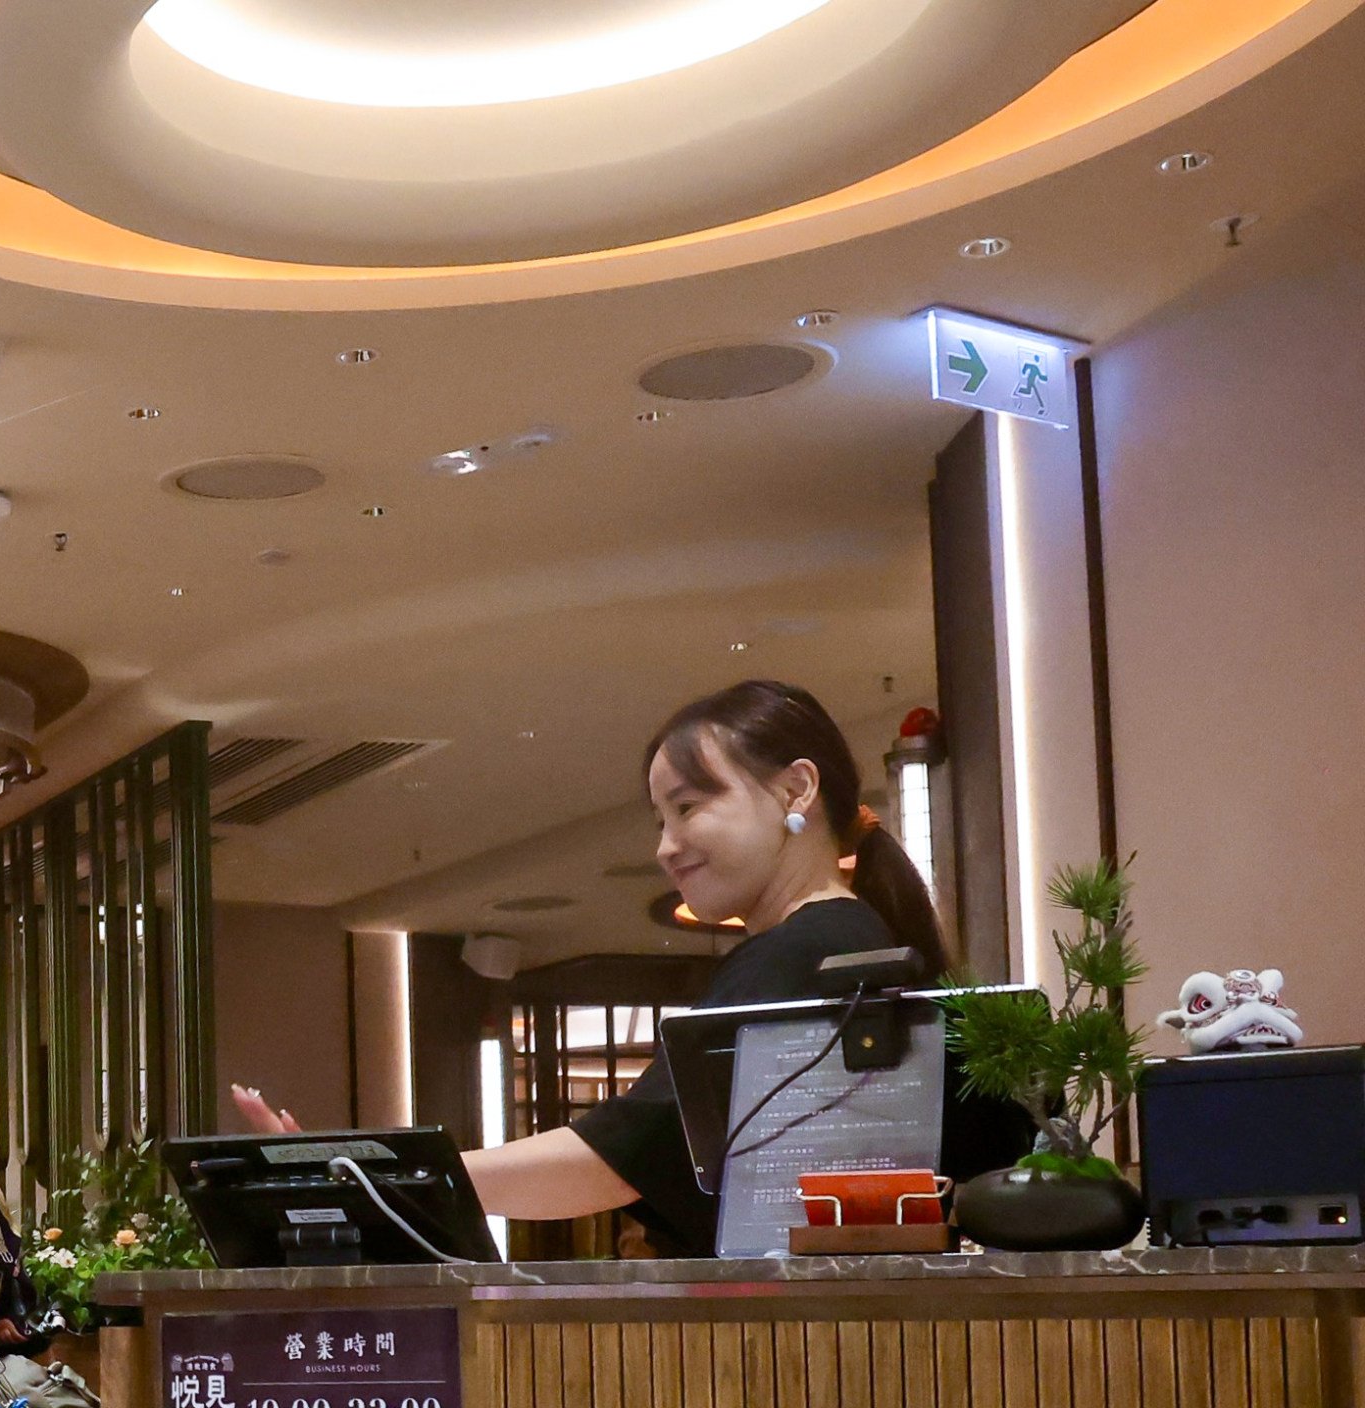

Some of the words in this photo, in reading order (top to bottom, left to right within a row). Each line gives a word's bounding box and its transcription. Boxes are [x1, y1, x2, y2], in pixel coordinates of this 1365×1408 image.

[284, 1331, 396, 1360] 營業時間
[305, 1364, 346, 1373] BUSINESS
[349, 1364, 381, 1373] HOURS
